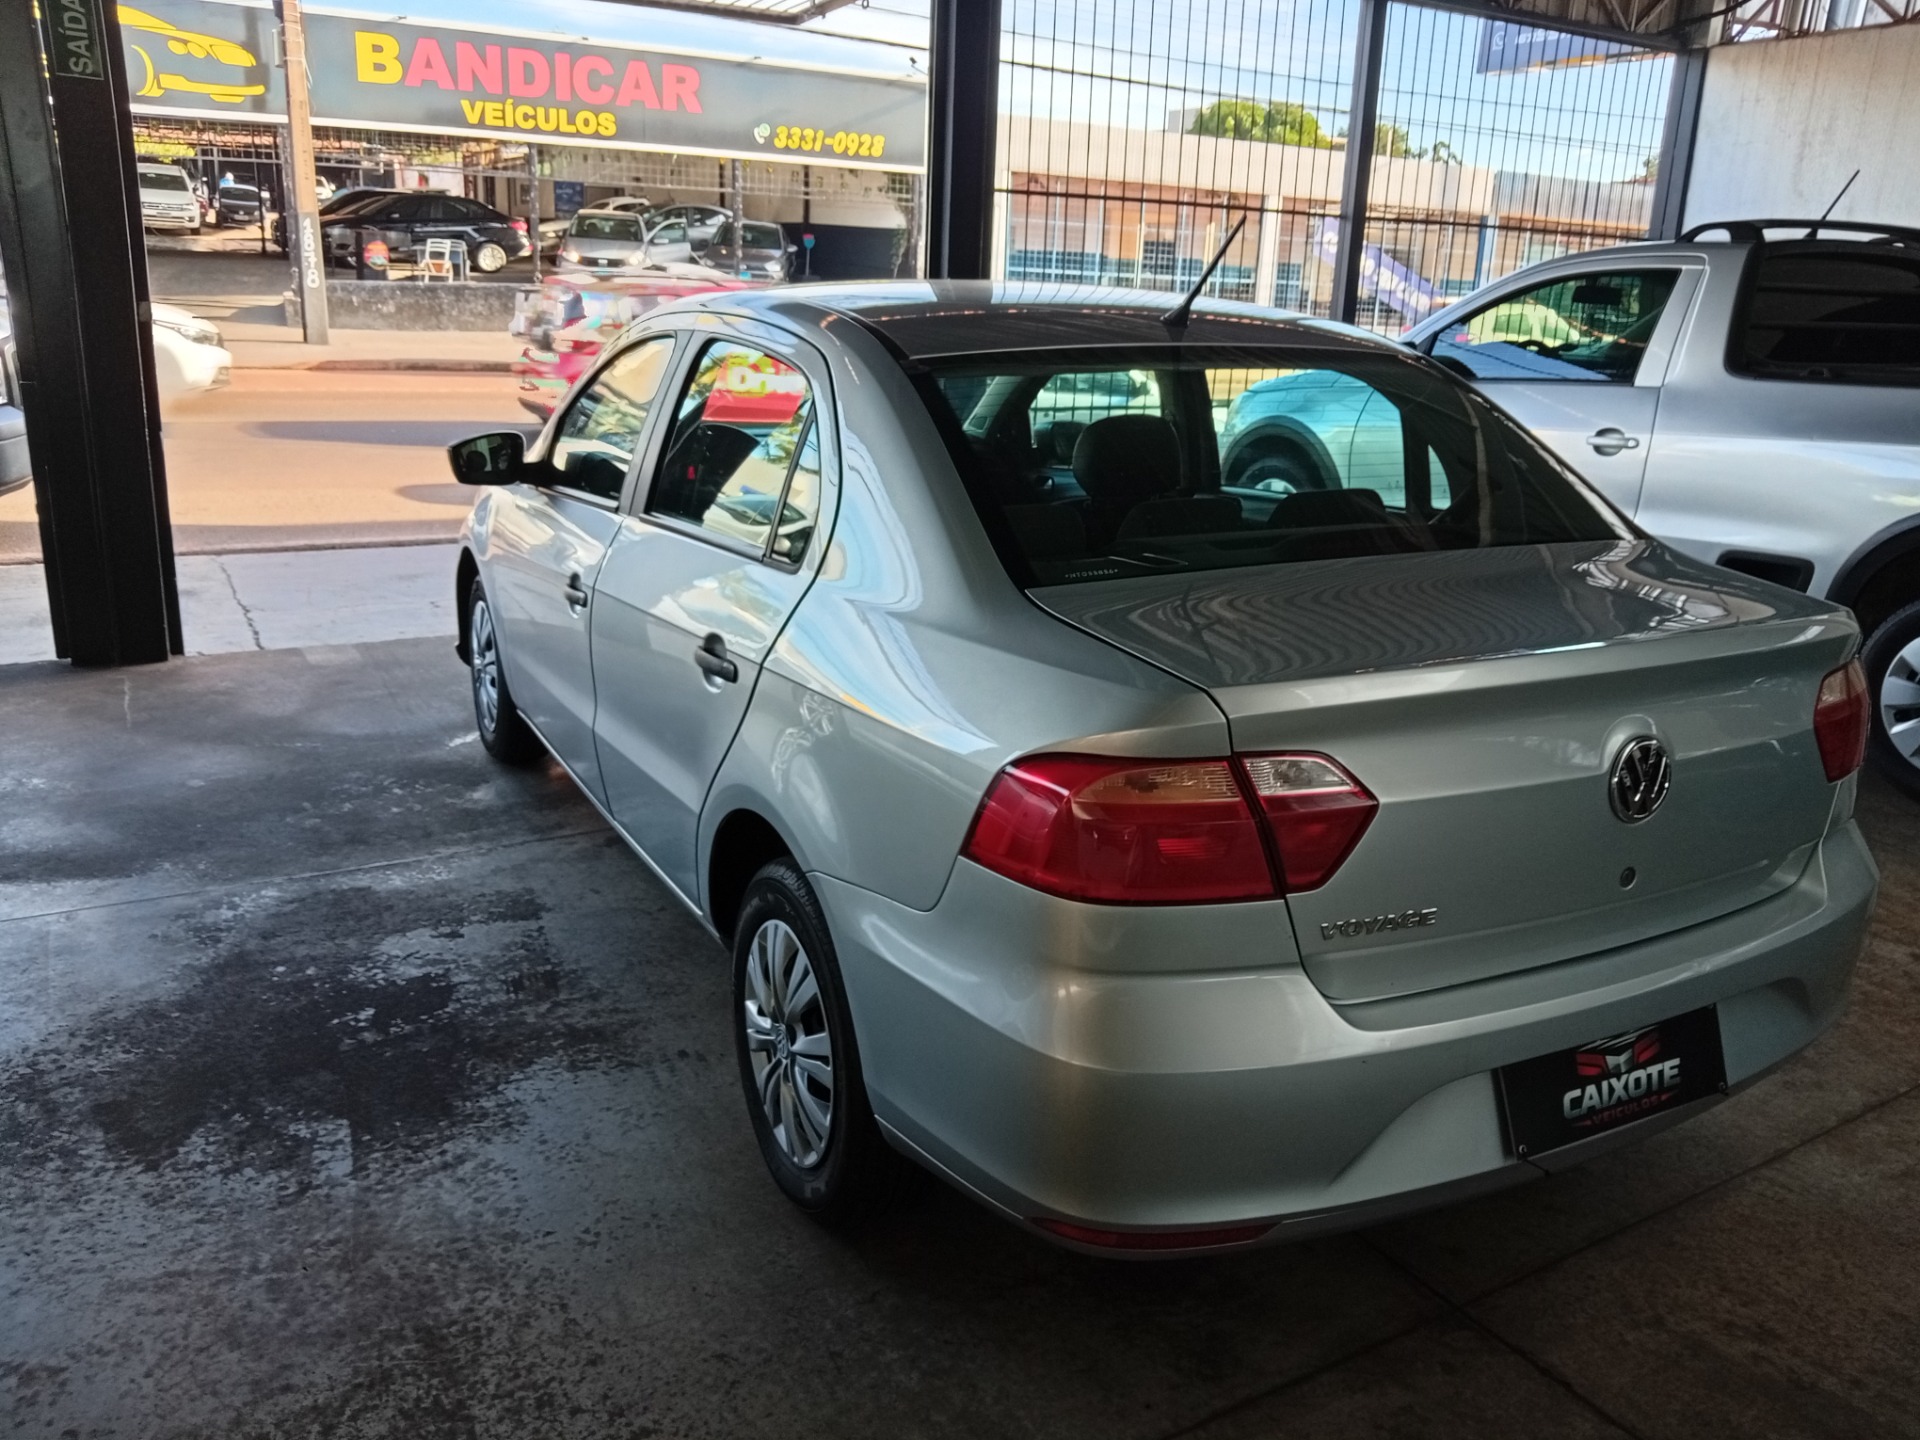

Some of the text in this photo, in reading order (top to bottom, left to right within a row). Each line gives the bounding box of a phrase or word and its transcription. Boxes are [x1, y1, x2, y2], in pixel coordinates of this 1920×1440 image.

[58, 0, 94, 74] SAÍDA
[354, 31, 703, 114] BANDICAR
[460, 98, 618, 138] VEÍCULOS
[773, 125, 886, 157] 3331-0928
[1320, 907, 1438, 941] VOYAGE
[1562, 1057, 1681, 1119] CAIXOTE
